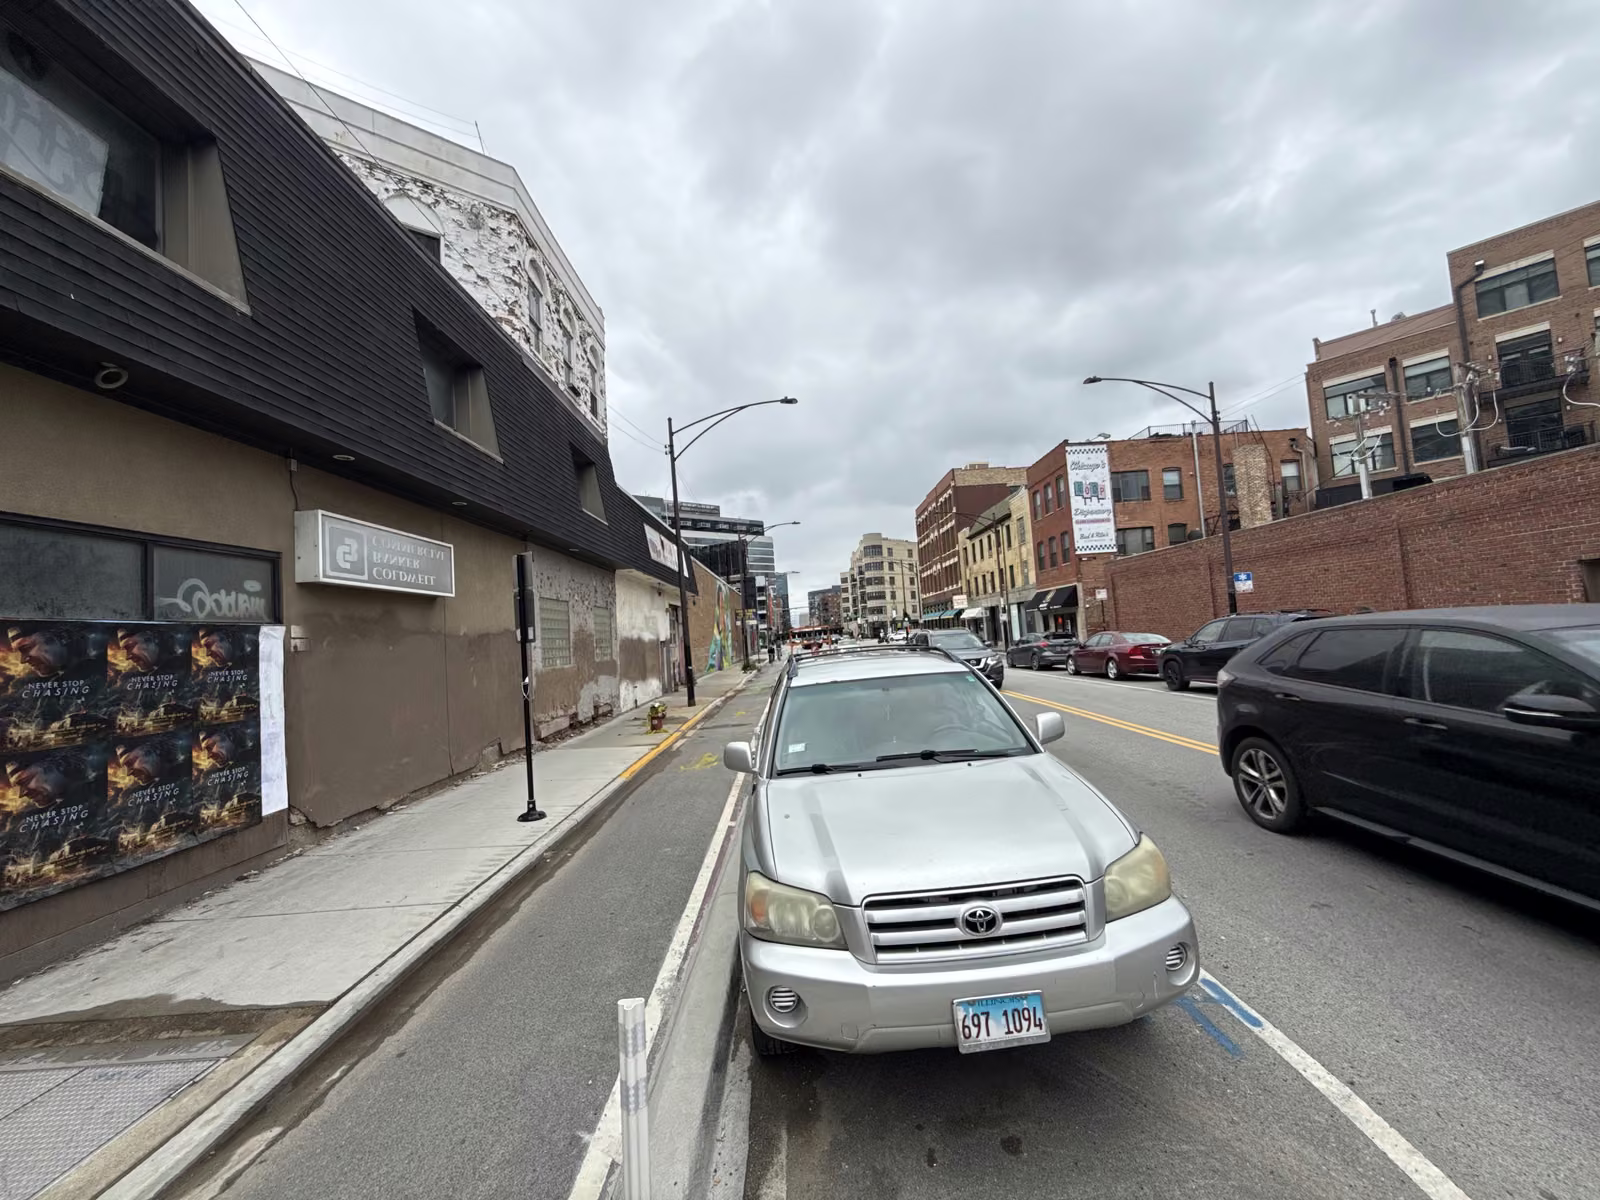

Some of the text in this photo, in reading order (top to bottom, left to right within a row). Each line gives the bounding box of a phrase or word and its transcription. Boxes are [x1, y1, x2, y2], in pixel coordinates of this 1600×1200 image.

[28, 680, 84, 690] NEVER STOP
[127, 680, 178, 690] CHASING
[131, 674, 174, 683] NEVER STOP
[207, 675, 248, 683] CHASING
[22, 686, 90, 698] CHASING
[207, 771, 249, 786] CHASING
[128, 788, 180, 807] CHASING
[132, 783, 175, 798] NEVER STOP
[20, 810, 89, 832] CHASING
[26, 804, 84, 823] NEVER STOP
[962, 1006, 1043, 1039] 697 1094
